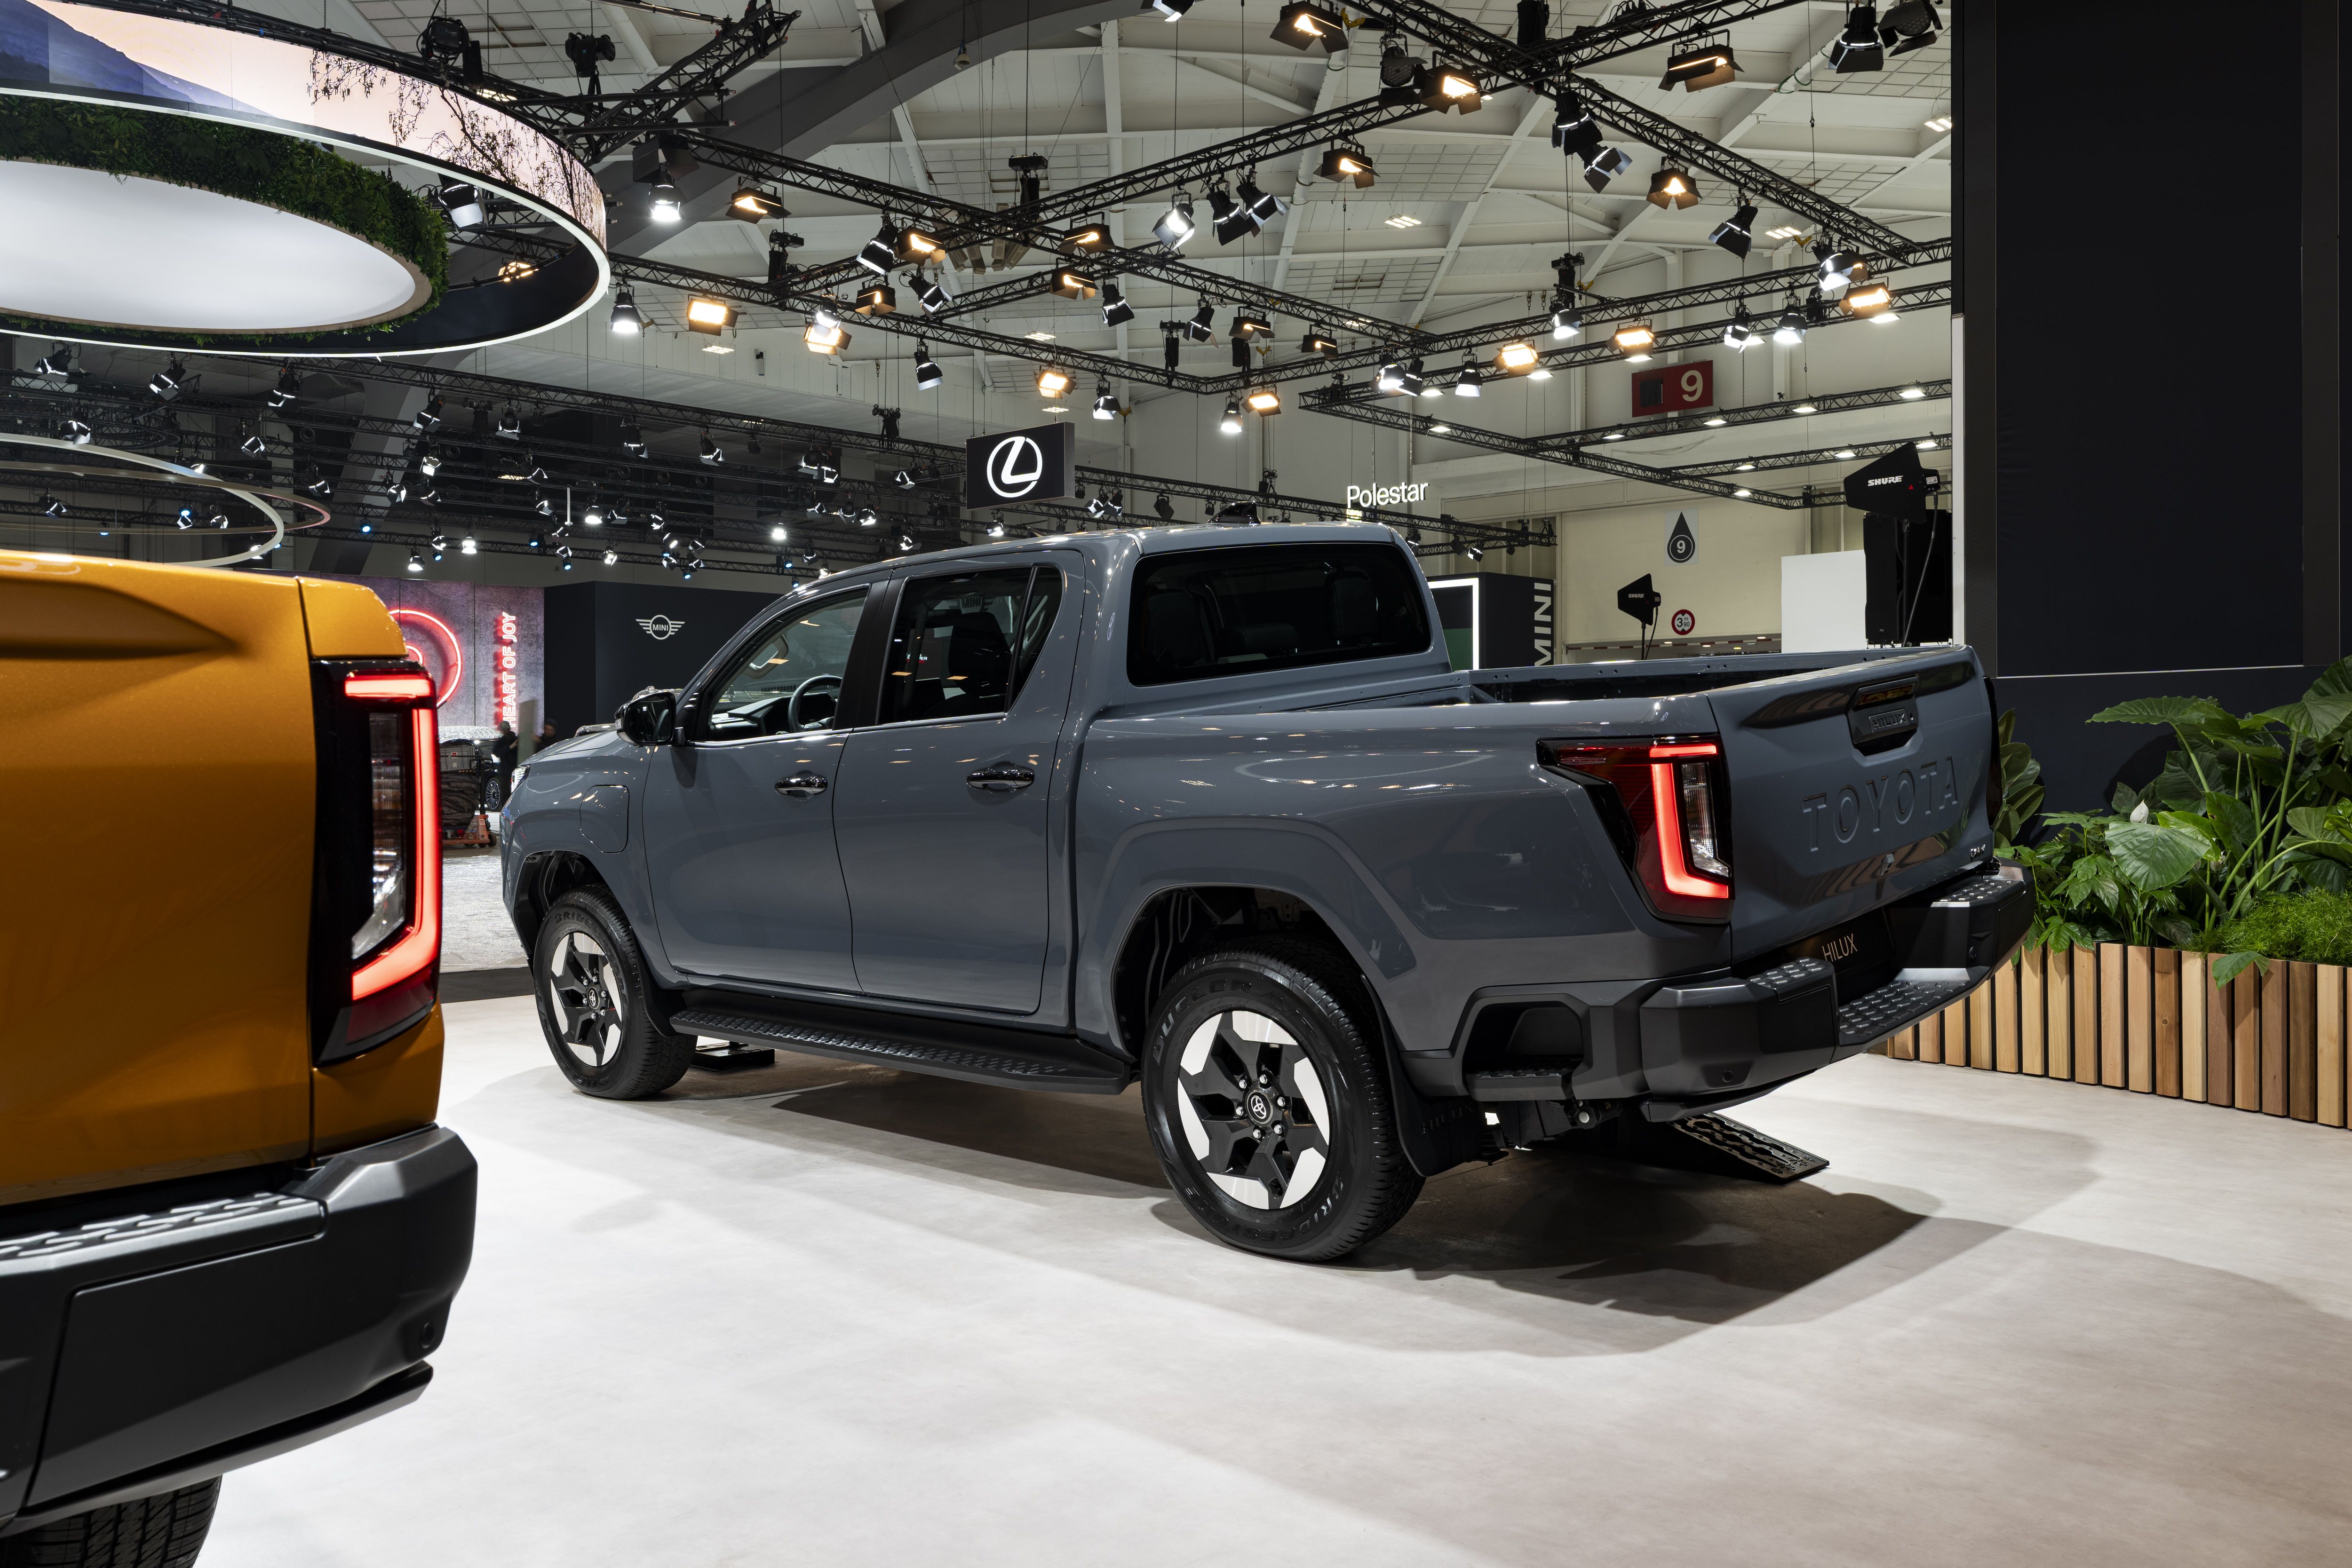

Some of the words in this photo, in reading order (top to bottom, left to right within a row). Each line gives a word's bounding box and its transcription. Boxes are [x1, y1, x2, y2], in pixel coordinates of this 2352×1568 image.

[1681, 370, 1703, 402] 9
[1347, 482, 1430, 508] Polestar
[1867, 475, 1902, 486] SHURE
[1677, 540, 1686, 554] 9
[502, 611, 517, 643] JOY
[1534, 582, 1551, 666] MINI
[1677, 617, 1683, 628] 3
[502, 646, 516, 668] OF
[502, 671, 516, 728] HEART
[1872, 713, 1907, 729] HILUX
[1802, 756, 1958, 852] TOYOTA
[555, 911, 629, 1007] BRIDGESTONE
[1822, 933, 1858, 962] HILUX
[1152, 978, 1252, 1066] DUELER
[1422, 1104, 1476, 1133] HILUX
[1184, 1173, 1344, 1242] BRIDGESTONE
